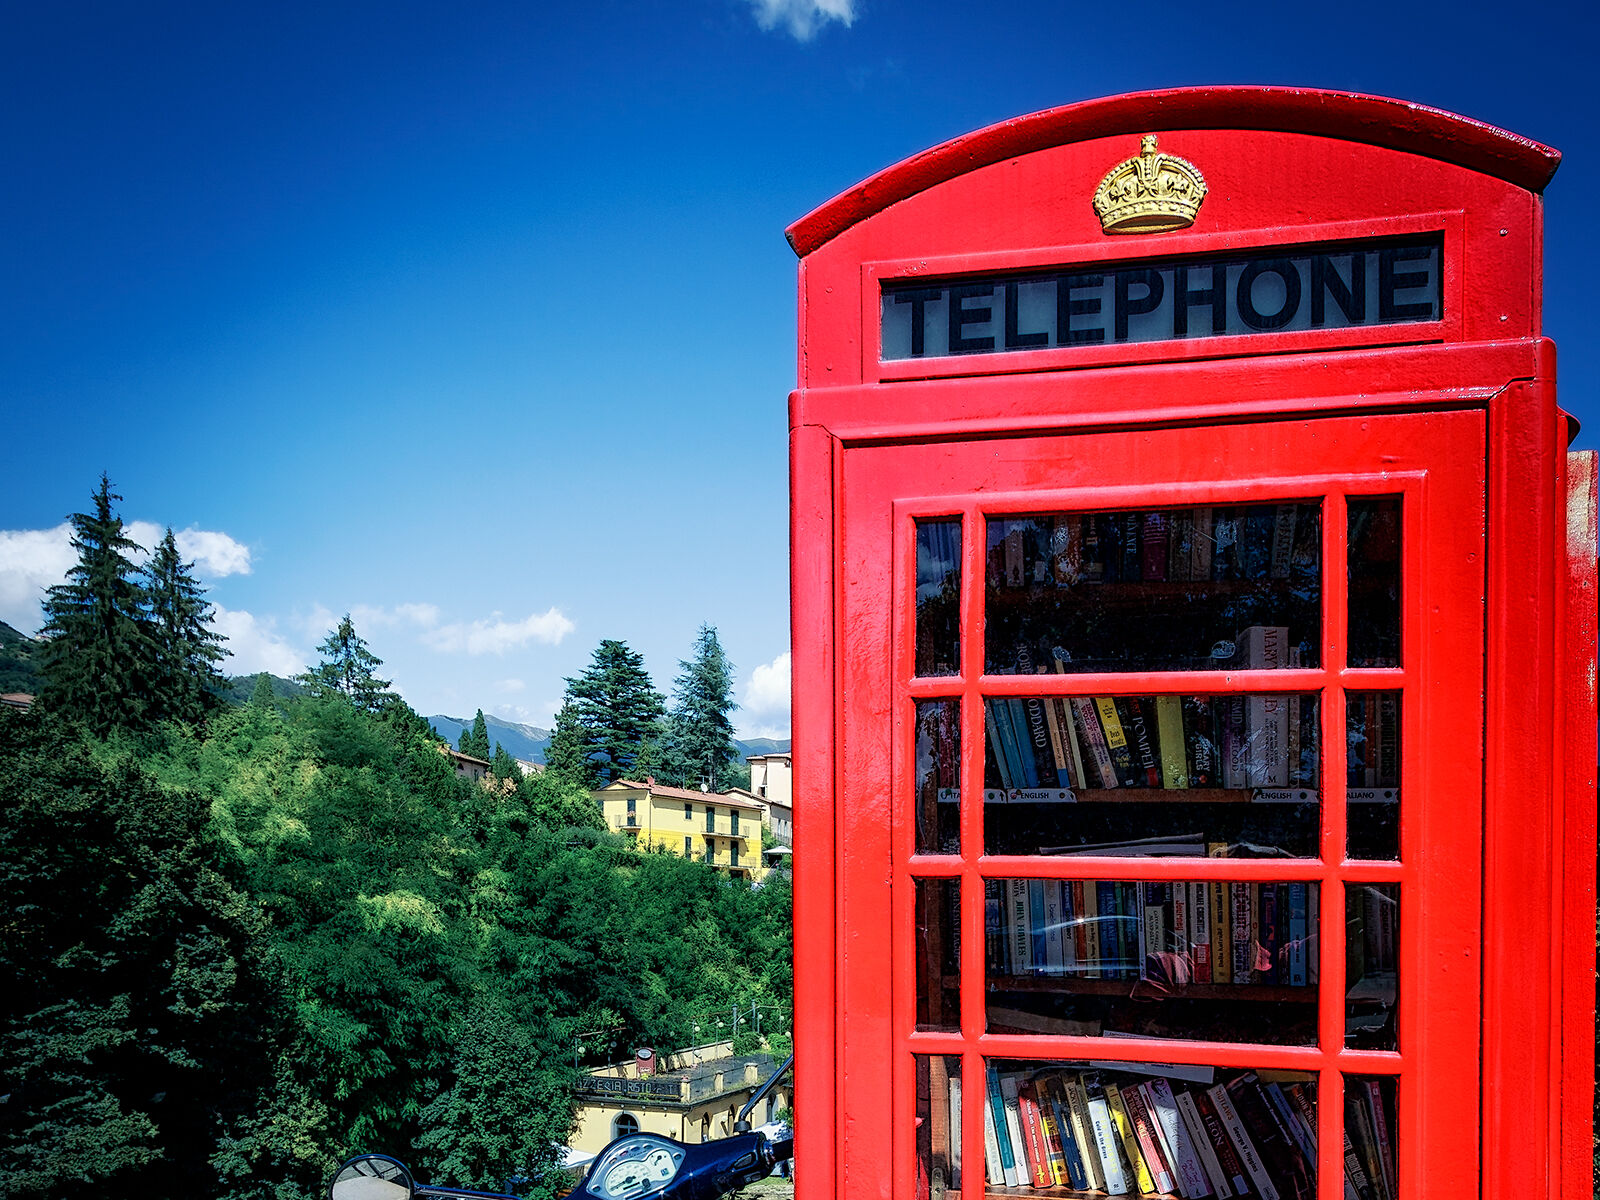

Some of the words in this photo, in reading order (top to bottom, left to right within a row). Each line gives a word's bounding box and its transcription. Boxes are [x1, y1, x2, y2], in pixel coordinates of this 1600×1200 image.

[895, 247, 1436, 358] TELEPHONE
[1132, 717, 1155, 769] POMPEII
[1020, 789, 1049, 799] ENGLISH
[1016, 900, 1024, 920] JOHN
[1175, 900, 1184, 931] Journey
[1126, 1097, 1138, 1115] TIME
[1130, 1089, 1144, 1109] JOHN
[1137, 1107, 1155, 1139] GRISHAM
[1203, 1114, 1225, 1147] LEON
[1213, 1089, 1235, 1121] OUTLAWS
[1231, 1125, 1248, 1146] George
[1243, 1150, 1260, 1173] Higgins
